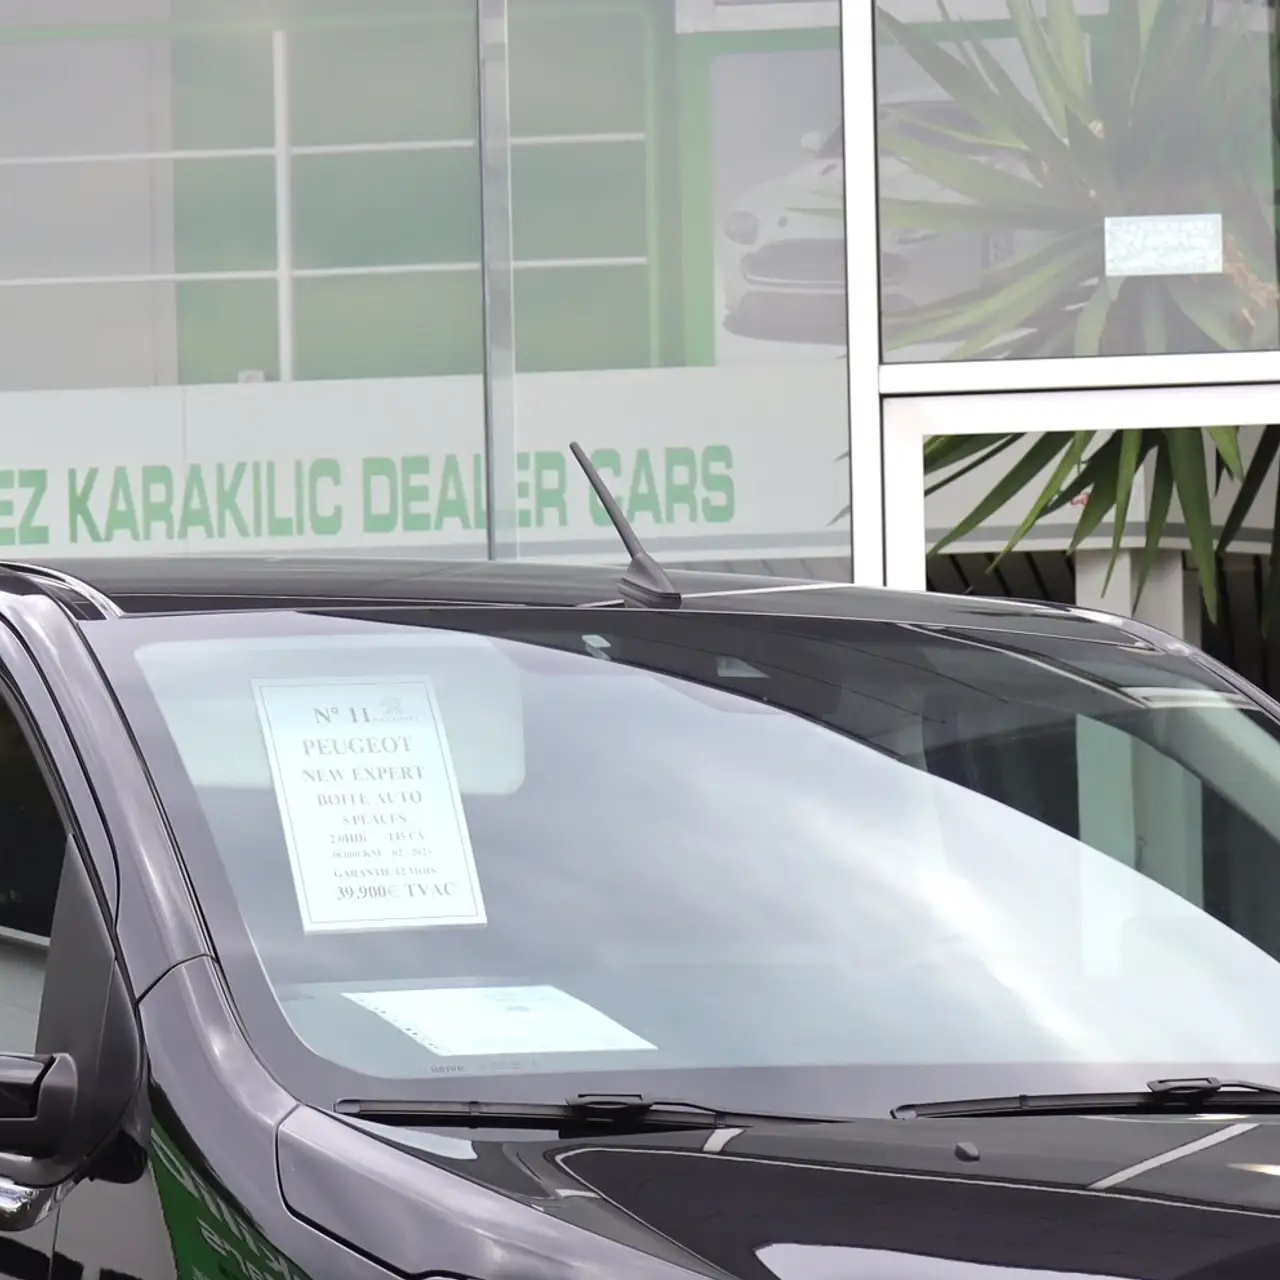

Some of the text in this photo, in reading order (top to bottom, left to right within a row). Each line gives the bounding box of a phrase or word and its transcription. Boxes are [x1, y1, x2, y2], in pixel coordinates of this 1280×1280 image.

[67, 458, 343, 543] KARAKILIC
[361, 450, 569, 533] DEALER
[588, 445, 736, 525] CARS
[301, 735, 413, 757] PEUGEOT
[301, 765, 426, 783] NEW EXPERT
